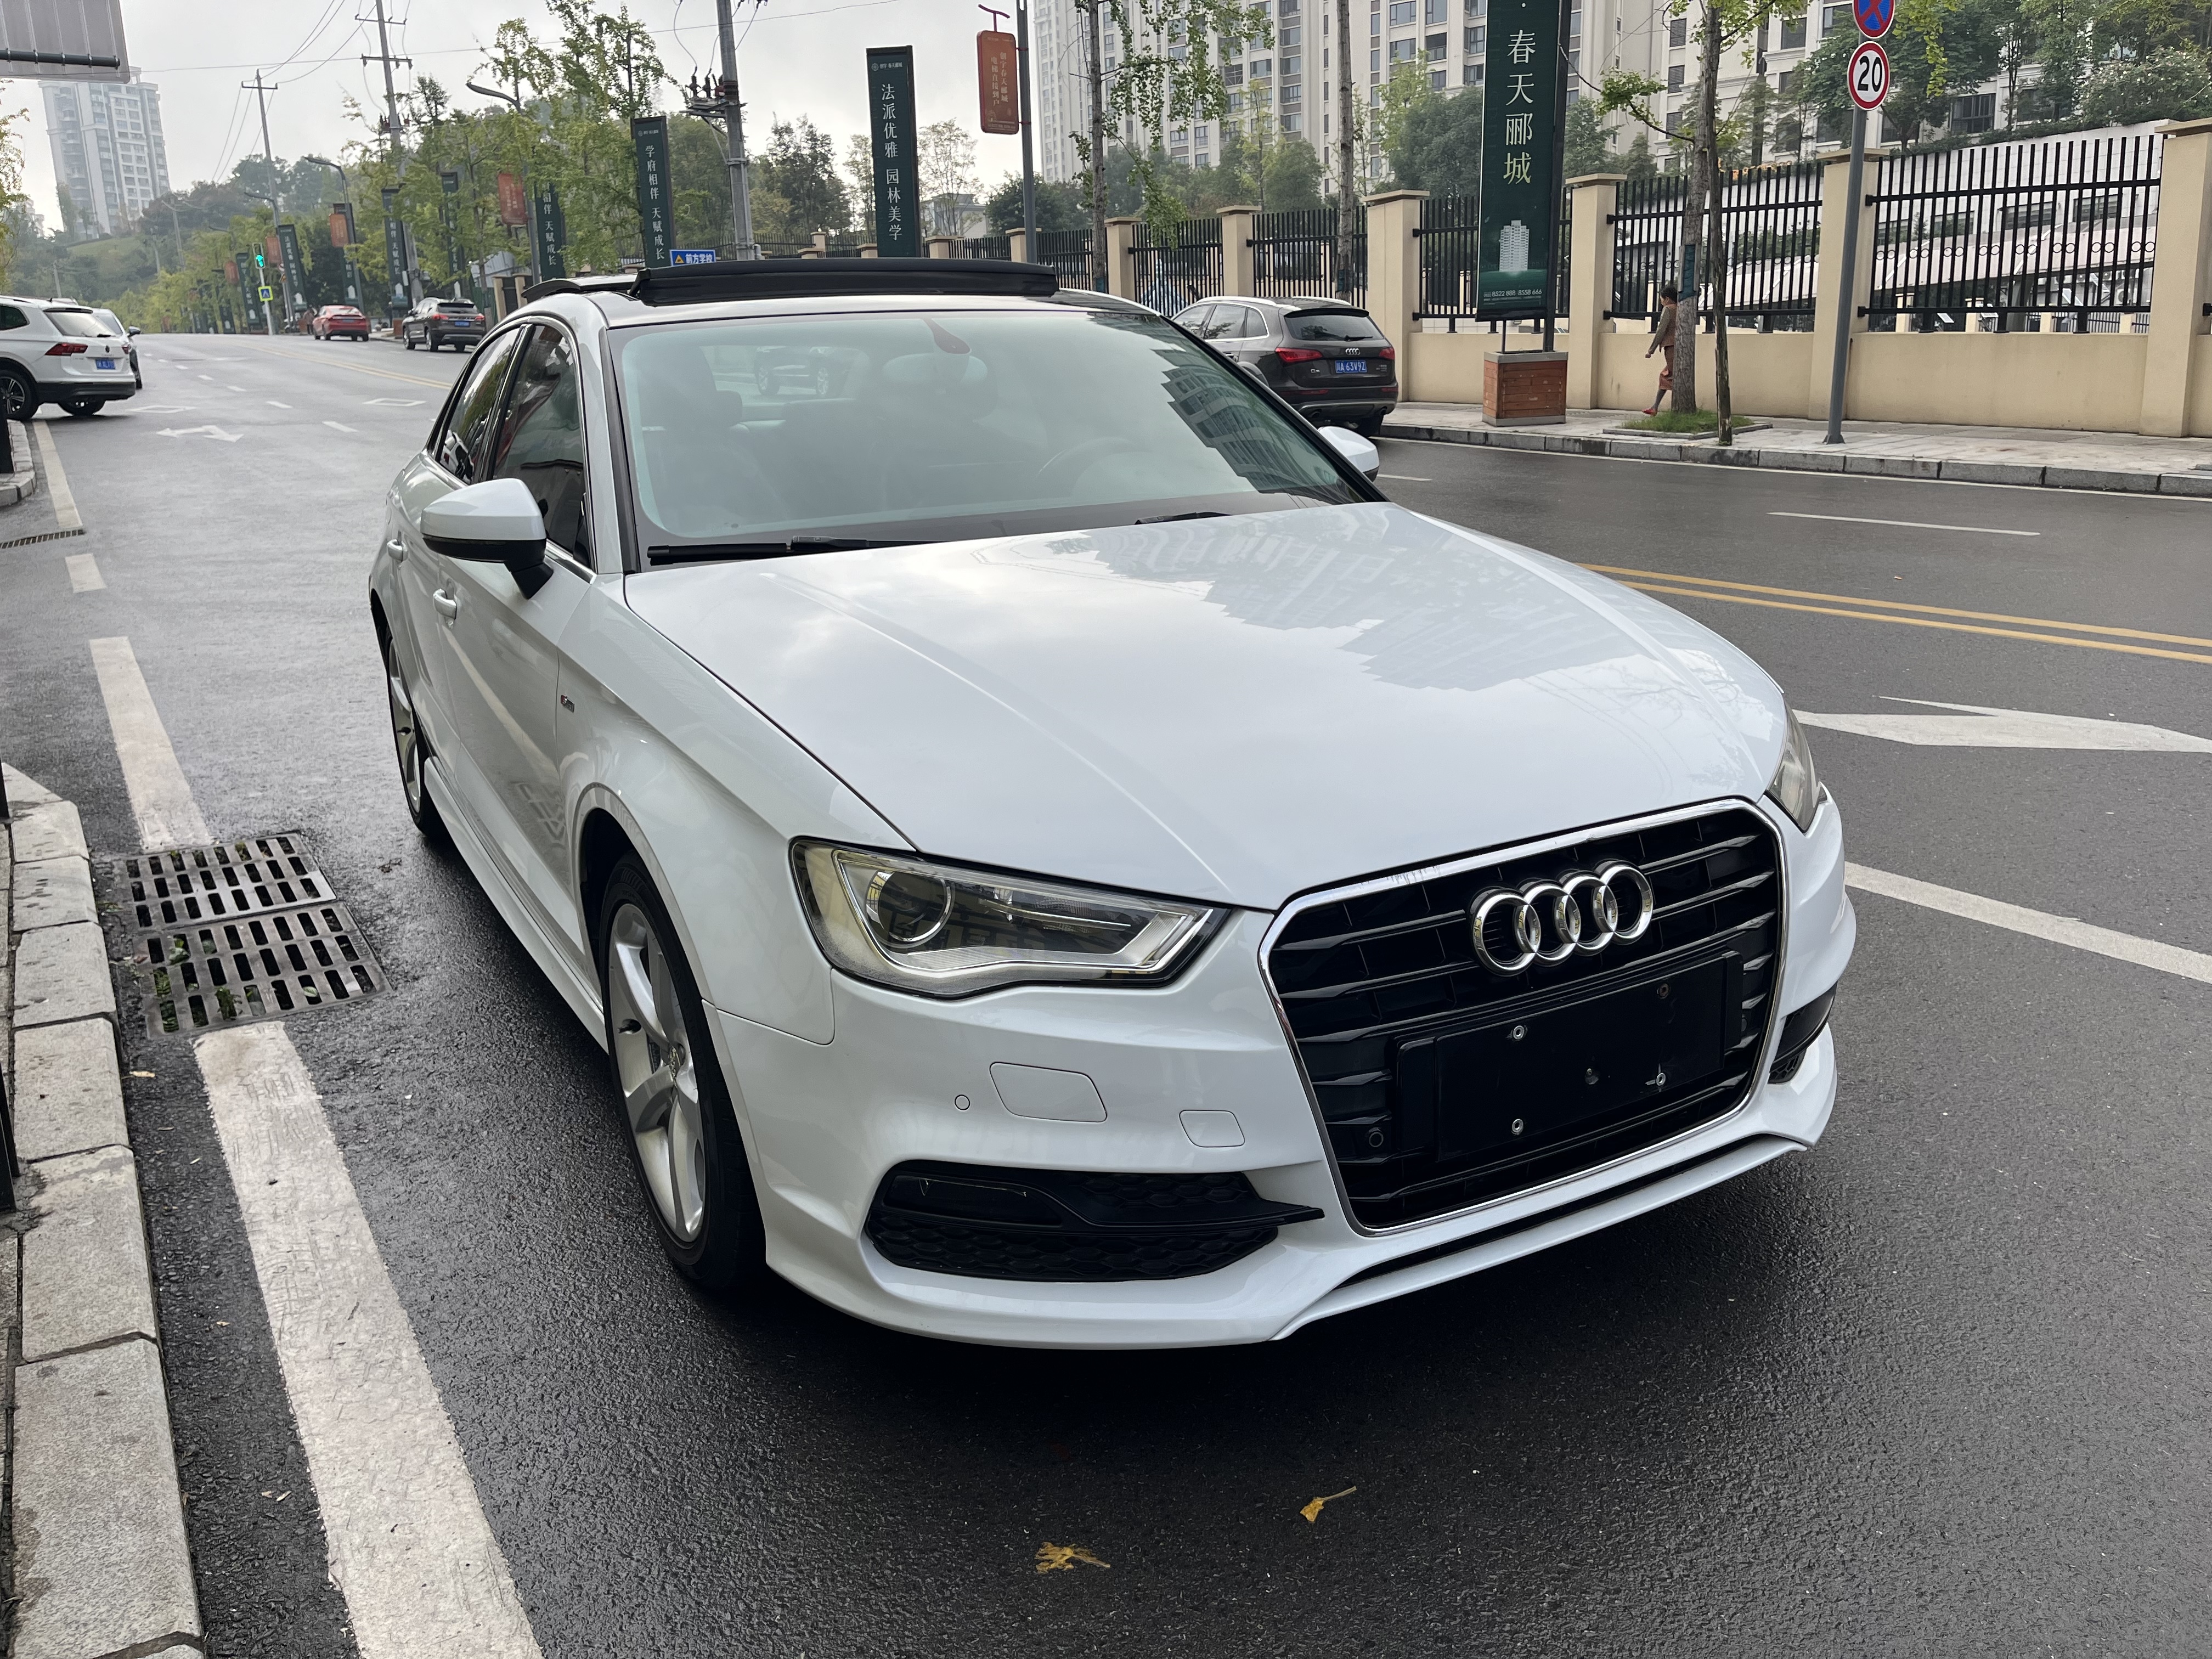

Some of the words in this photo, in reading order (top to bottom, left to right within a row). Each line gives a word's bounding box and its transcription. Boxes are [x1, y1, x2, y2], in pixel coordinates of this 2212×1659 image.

[1503, 30, 1536, 184] 春天郦城
[1858, 55, 1882, 92] 20
[881, 83, 898, 158] 法派优雅
[645, 145, 659, 200] 学府相伴
[652, 207, 665, 261] 天赋成长
[886, 168, 902, 241] 园林美学
[545, 221, 557, 266] 天赋成长
[685, 252, 713, 264] 前方学校
